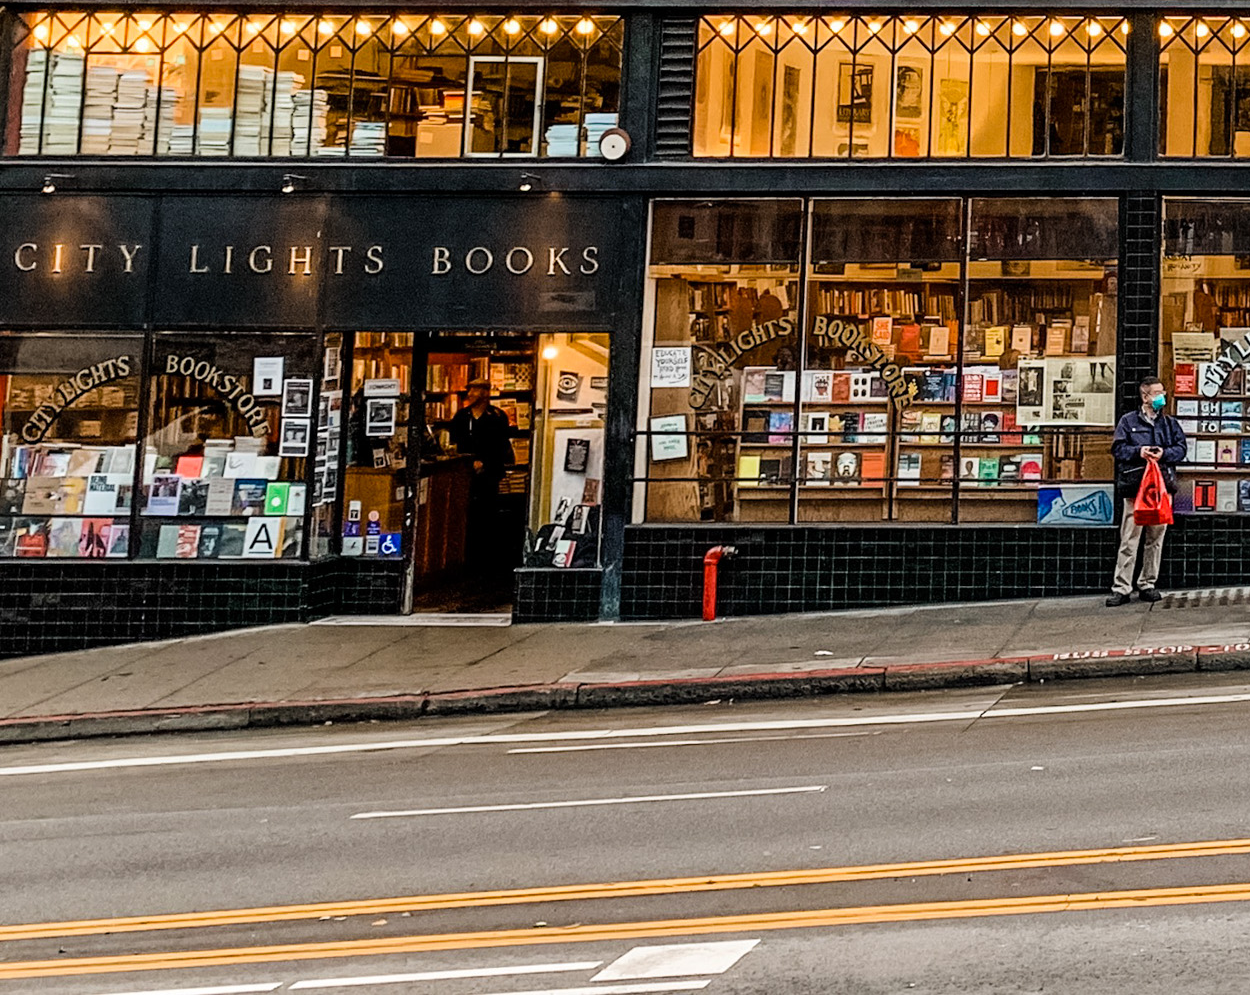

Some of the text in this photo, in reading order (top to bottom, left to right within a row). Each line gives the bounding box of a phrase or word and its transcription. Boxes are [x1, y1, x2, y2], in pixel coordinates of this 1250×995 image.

[14, 243, 600, 275] CITY LIGHTS BOOKS
[719, 315, 793, 366] LIGHTS
[813, 315, 915, 411] BOOKSTORE
[166, 355, 272, 439] BOOKSTORE
[1201, 347, 1239, 398] CITY
[22, 355, 131, 443] CITY LIGHTS
[250, 523, 273, 550] A
